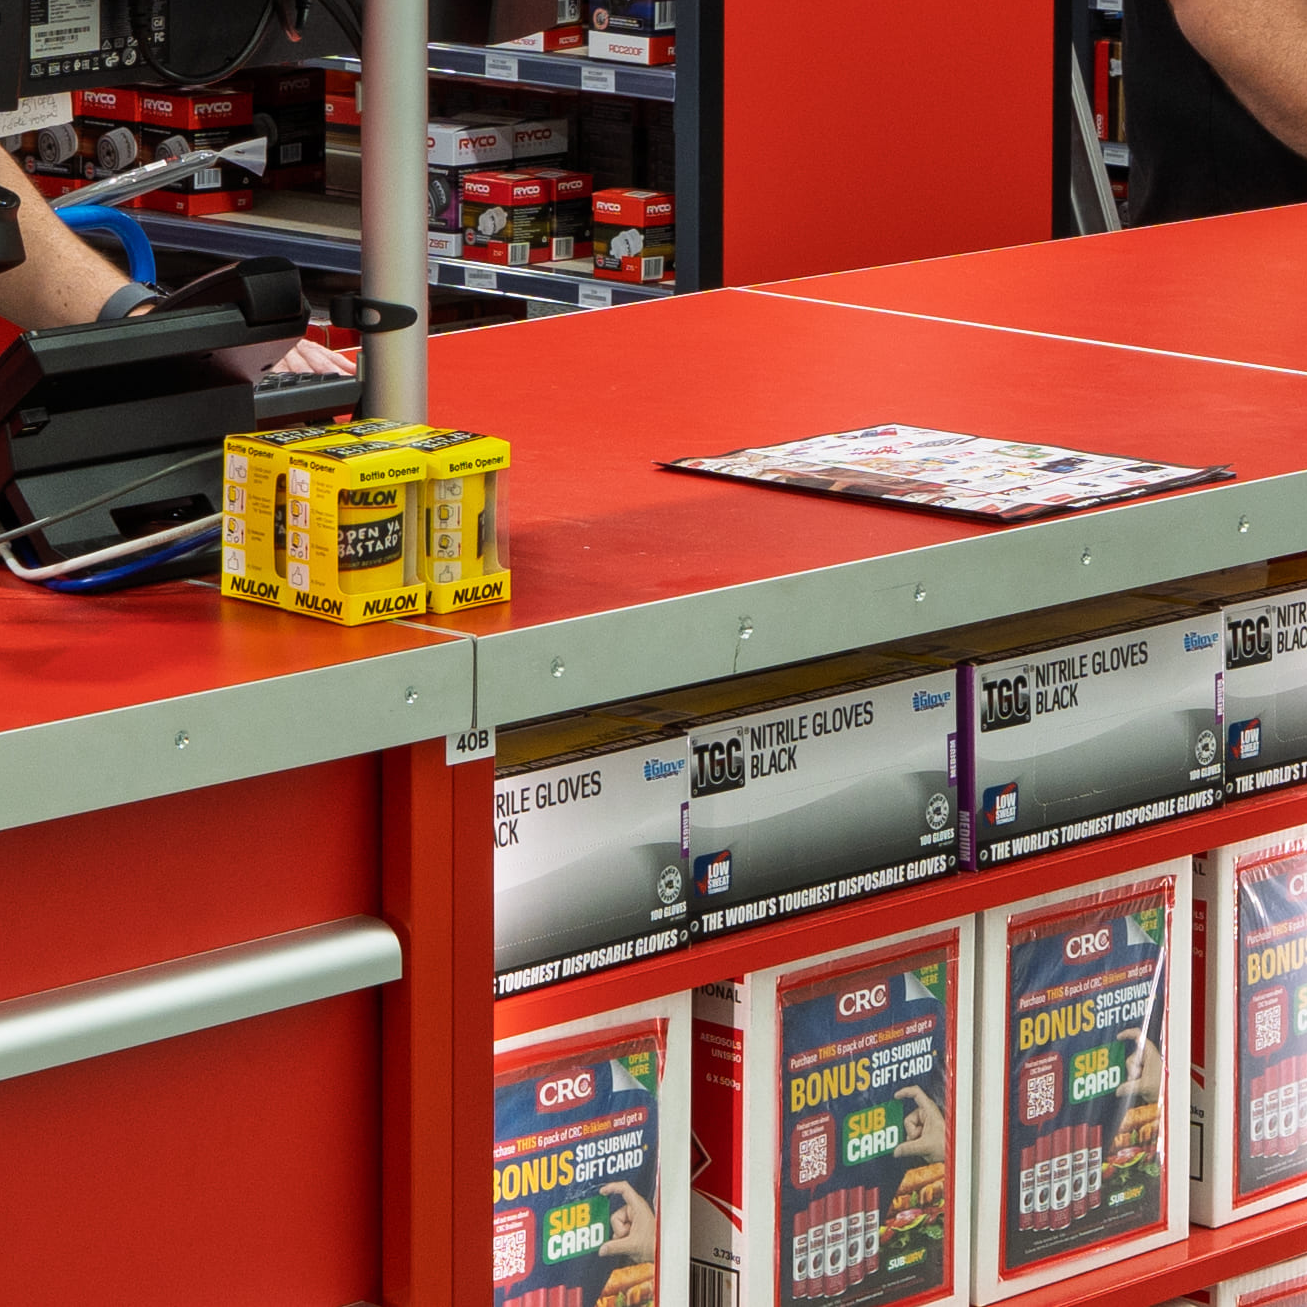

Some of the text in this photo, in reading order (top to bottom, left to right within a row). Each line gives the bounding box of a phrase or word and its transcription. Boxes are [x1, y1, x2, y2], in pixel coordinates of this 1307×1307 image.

[459, 135, 496, 150] RYCO
[596, 202, 621, 212] RYCO
[360, 466, 419, 482] Bottle Opener
[387, 519, 400, 535] YA
[231, 576, 279, 600] NULON
[295, 591, 342, 616] NULON
[453, 582, 503, 605] NULON
[363, 594, 418, 616] NULON
[1228, 615, 1271, 661] TGC
[1035, 641, 1148, 688] NITRILE GLOVES
[983, 675, 1028, 723] TGC
[1036, 683, 1078, 714] BLACK
[750, 700, 873, 751] NITRILE GLOVES
[456, 733, 489, 752] 40B
[693, 738, 742, 788] TGC
[751, 746, 797, 779] BLACK
[536, 770, 602, 808] GLOVES
[959, 811, 970, 862] MEDIUM
[990, 789, 1214, 862] THE WORLD'S TOUGHEST DISPOSABLE GLOVES
[707, 860, 730, 877] LOW
[702, 854, 947, 933] THE WORLD'S TOUGHEST DISPOSABLE GLOVES
[1066, 928, 1110, 960] CRC
[499, 930, 678, 992] TOUGHEST DISPOSABLE GLOVES
[839, 985, 886, 1016] CRC
[700, 1032, 741, 1049] AEROSOLS
[1020, 999, 1095, 1051] BONUS
[712, 1049, 741, 1063] UN1950
[791, 1053, 817, 1069] Purchase
[819, 1046, 836, 1060] THIS
[837, 1046, 842, 1055] 6
[843, 1041, 858, 1055] pack
[865, 1035, 878, 1047] CRC
[906, 1023, 917, 1035] and
[720, 1077, 740, 1091] 500g
[791, 1036, 933, 1112] BONUS $10 SUBWAY
[872, 1064, 899, 1088] GIFT
[539, 1073, 592, 1107] CRC
[848, 1107, 885, 1137] SUB
[847, 1124, 897, 1162] CARD
[713, 1247, 741, 1264] 3.73kg
